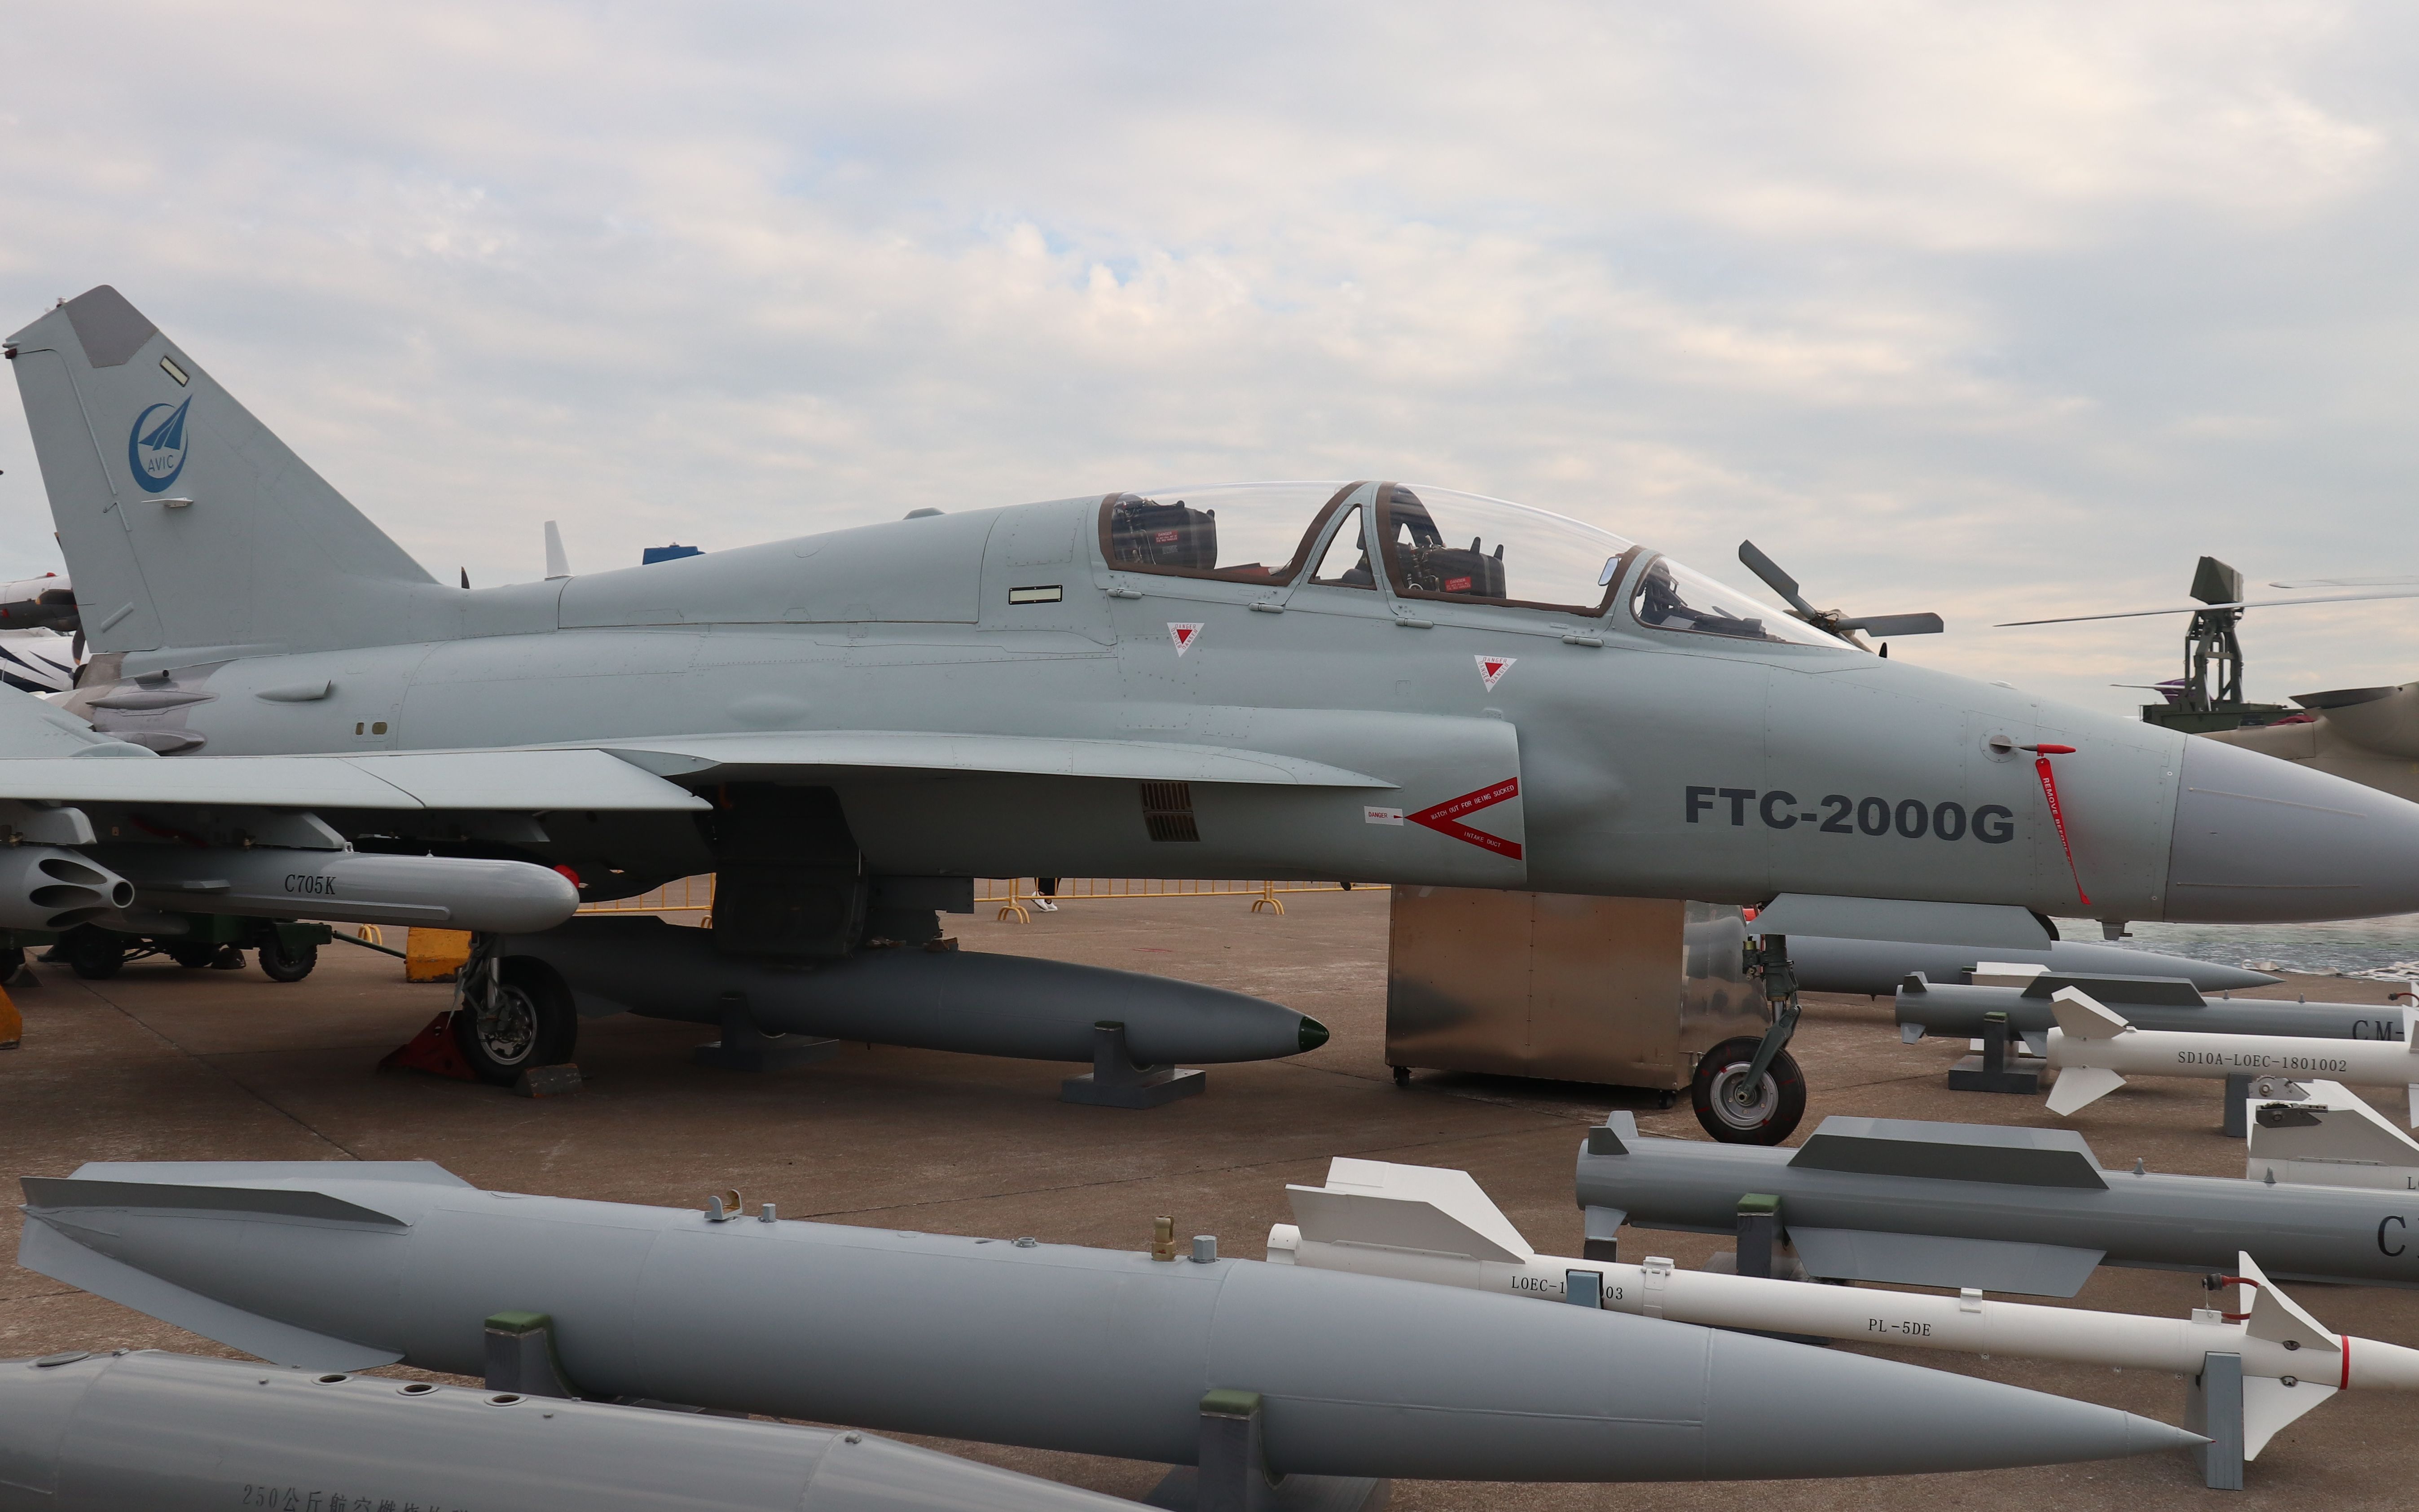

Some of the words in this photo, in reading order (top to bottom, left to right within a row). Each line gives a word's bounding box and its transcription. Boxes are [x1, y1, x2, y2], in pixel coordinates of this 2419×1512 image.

[147, 454, 174, 472] AVIC
[1170, 628, 1182, 649] DANGER
[1181, 629, 1198, 650] DANGER
[1478, 661, 1490, 682] DANGER
[1490, 663, 1509, 684] DANGER
[1430, 810, 1448, 820] WATCH
[1449, 805, 1459, 813] OUT
[1461, 800, 1473, 809] FOR
[1474, 793, 1491, 804] BEING
[1493, 785, 1514, 797] SUCKED
[2043, 777, 2058, 814] REMOVE
[1685, 786, 2014, 844] FTC-2000G
[1464, 831, 1484, 842] INTAKE
[1487, 839, 1501, 848] DUCT
[285, 874, 336, 895] C705K
[2178, 1051, 2347, 1072] SD10A-LOEC-1801002
[2407, 1176, 2419, 1190] L
[2378, 1215, 2419, 1259] C
[1868, 1318, 1931, 1336] PL-5DE
